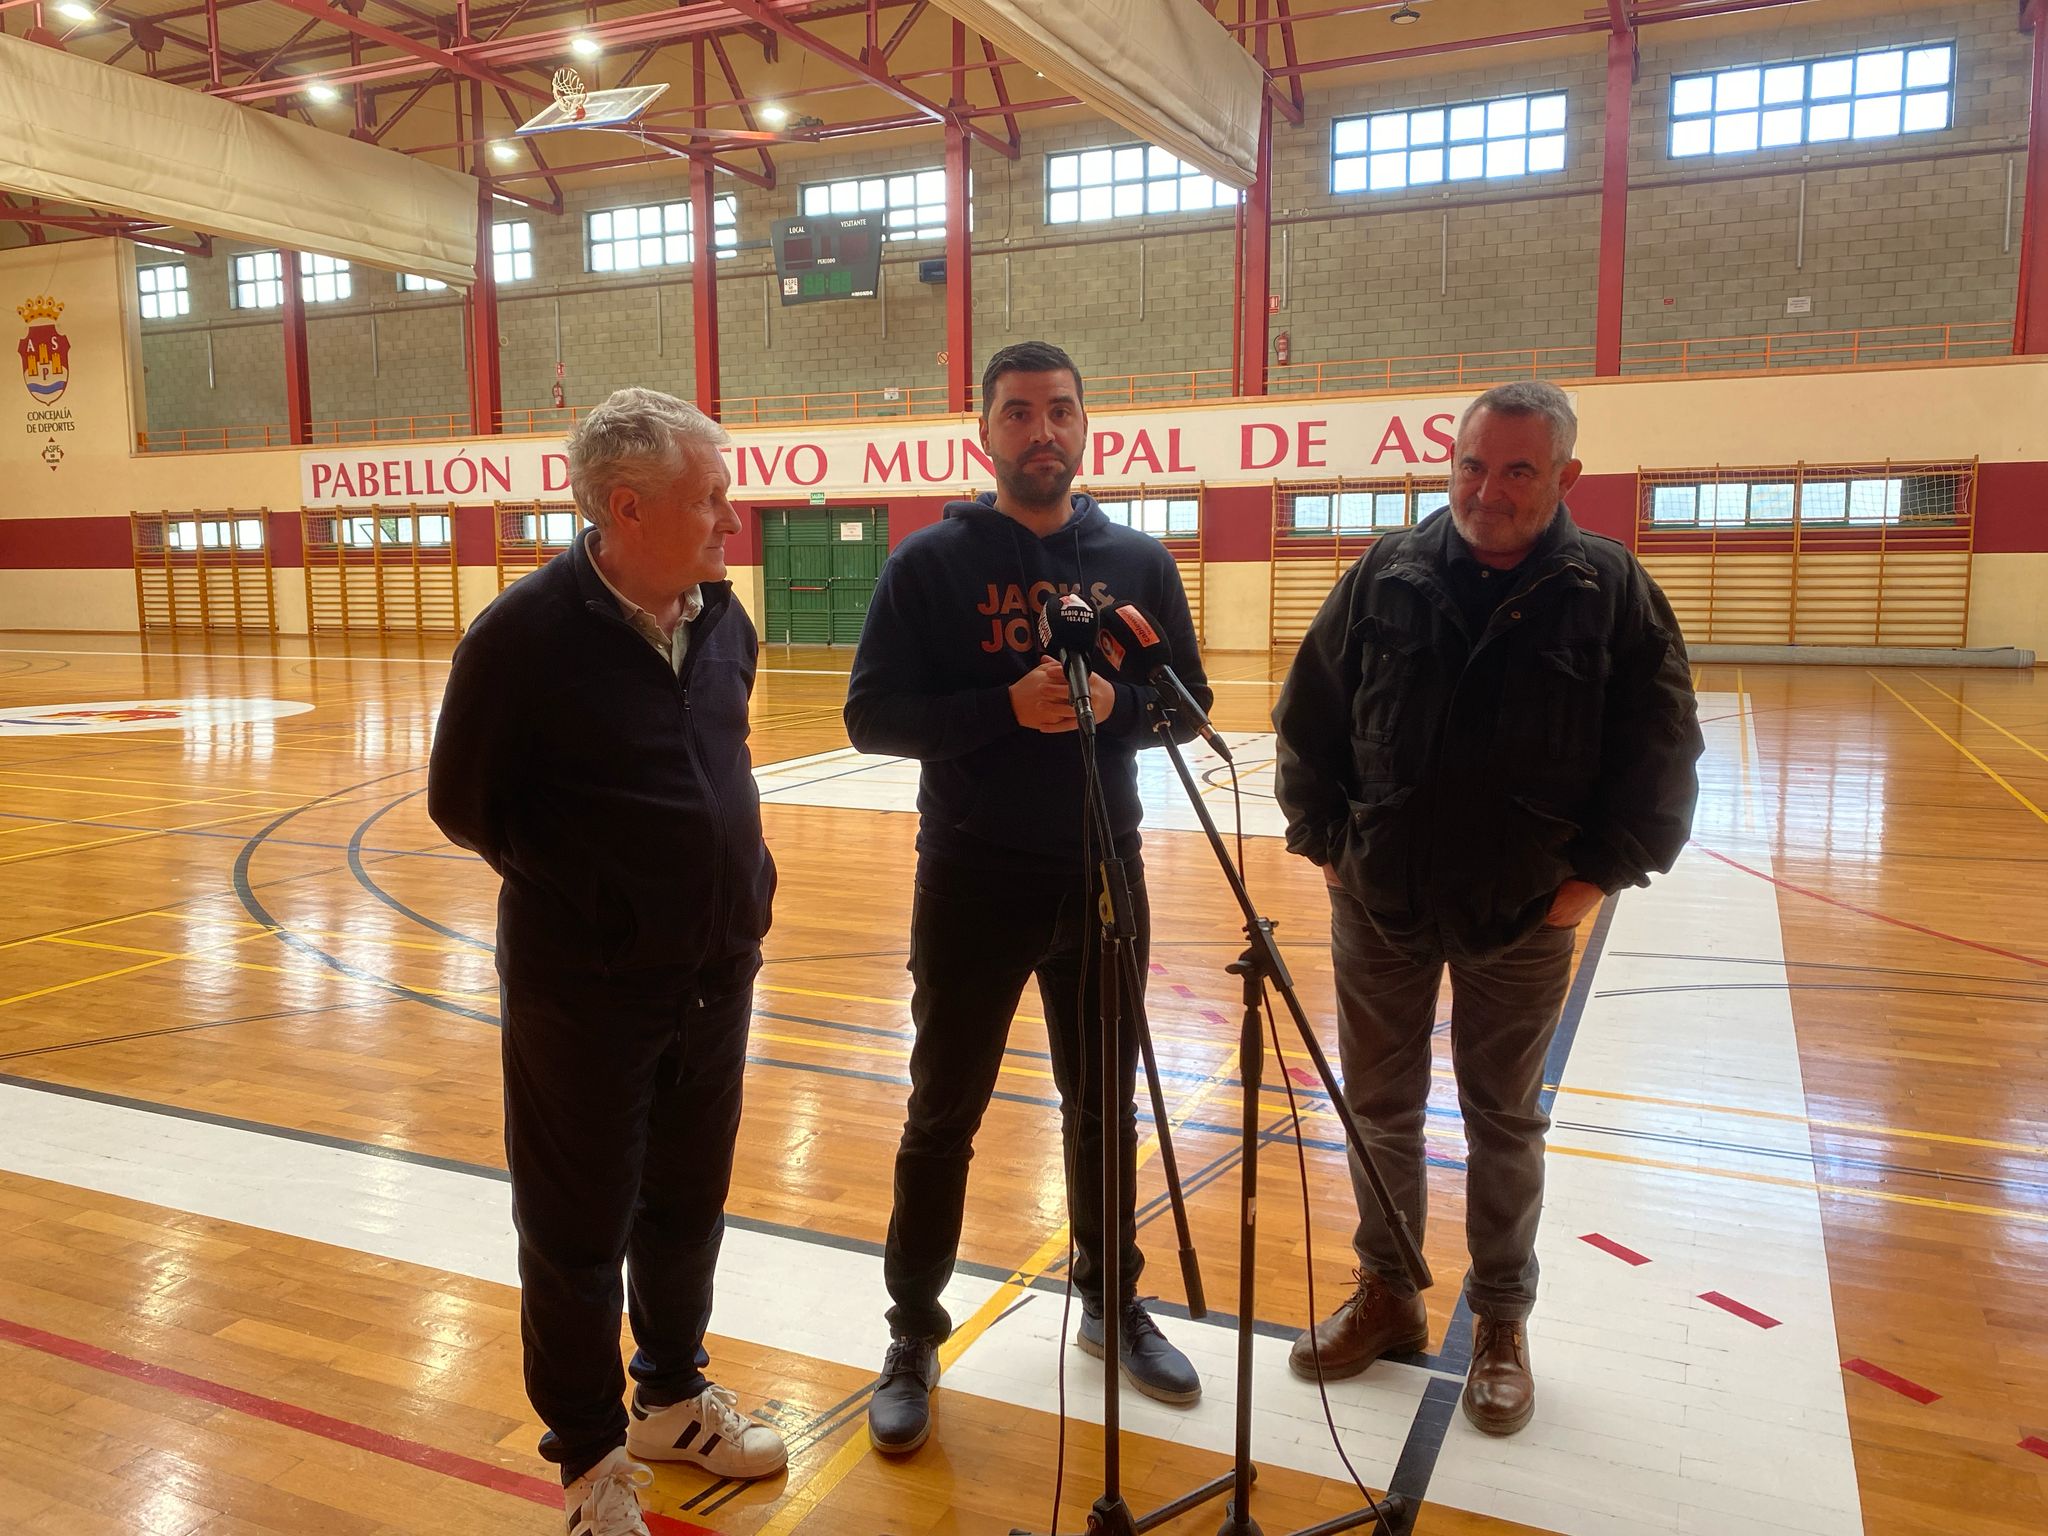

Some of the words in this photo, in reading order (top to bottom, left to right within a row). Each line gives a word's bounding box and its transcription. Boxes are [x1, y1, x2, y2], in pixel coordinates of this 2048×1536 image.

[840, 219, 867, 228] VISITANTE
[27, 407, 72, 422] CONCEJALÍA
[26, 424, 37, 434] DE
[38, 422, 76, 433] DEPORTES
[45, 445, 60, 453] ASPE
[312, 448, 511, 498] PABELLÓN
[863, 428, 1196, 484] MUNPAL
[1240, 420, 1327, 470] DE
[977, 581, 1081, 615] JAC
[1079, 611, 1094, 619] ASPE
